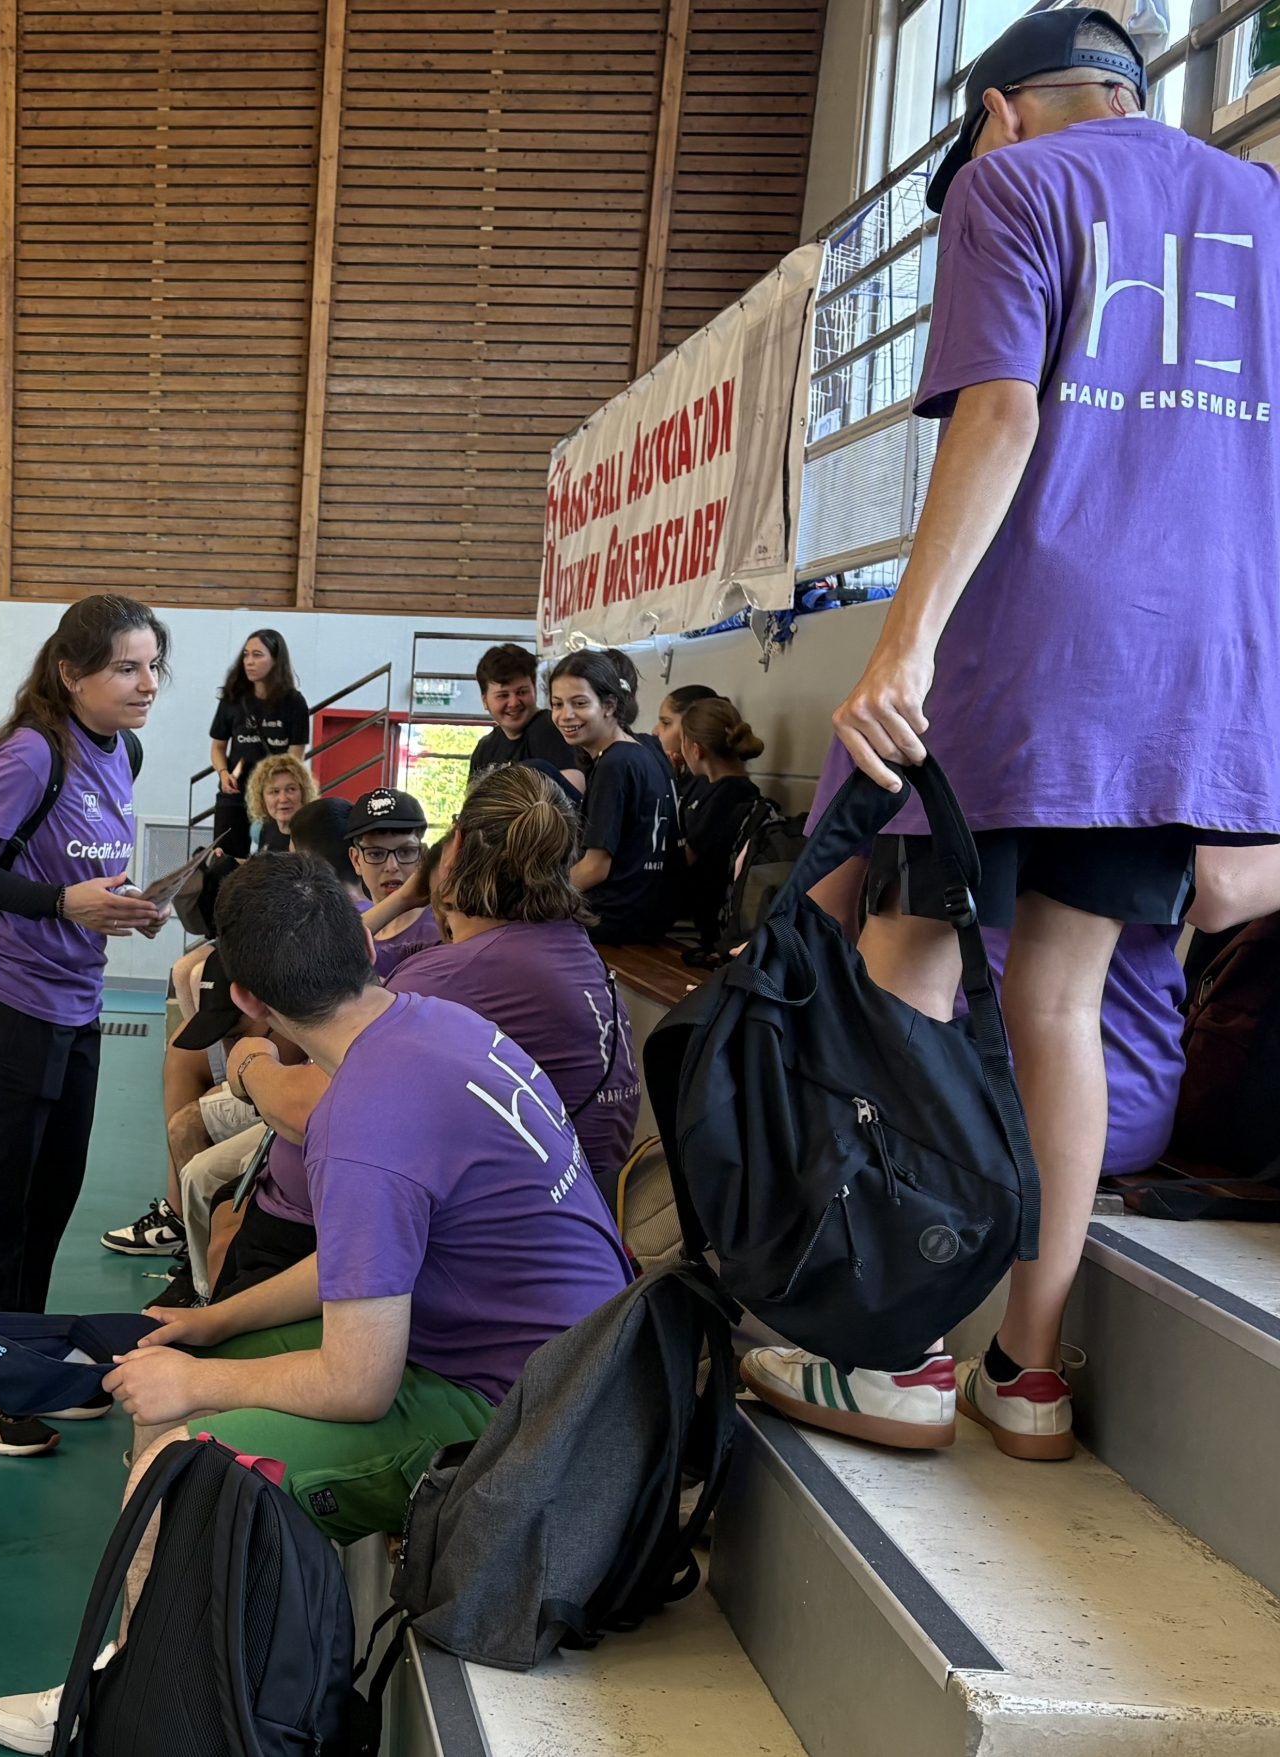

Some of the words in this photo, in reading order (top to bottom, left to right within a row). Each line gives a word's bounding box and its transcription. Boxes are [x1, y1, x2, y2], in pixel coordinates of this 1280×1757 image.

[1060, 382, 1125, 411] HAND
[1140, 389, 1272, 423] ENSEMBLE
[66, 840, 112, 859] Crédit
[550, 1164, 578, 1204] HAND
